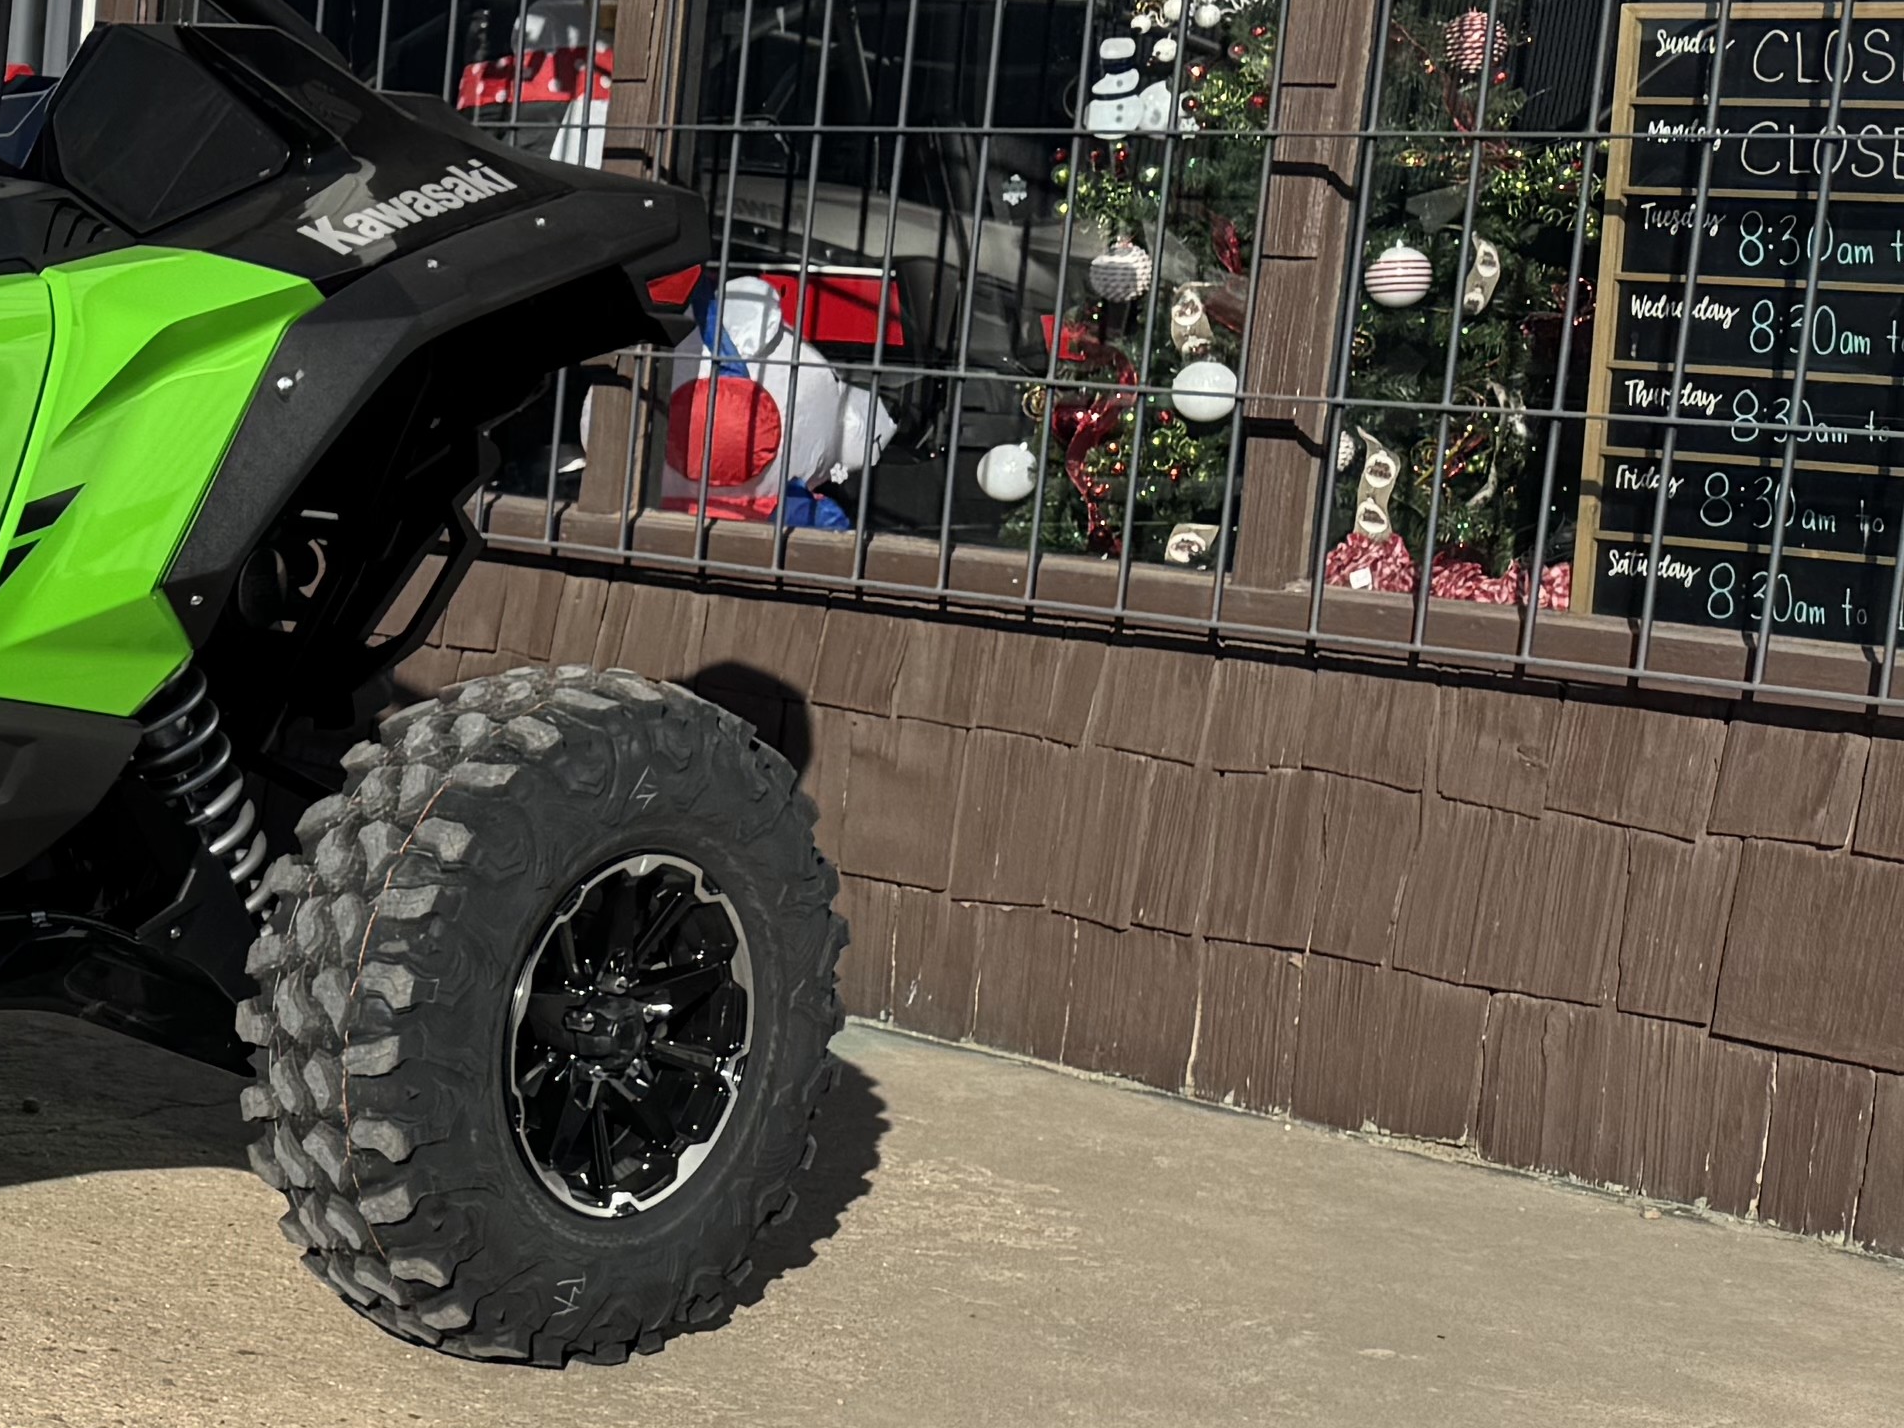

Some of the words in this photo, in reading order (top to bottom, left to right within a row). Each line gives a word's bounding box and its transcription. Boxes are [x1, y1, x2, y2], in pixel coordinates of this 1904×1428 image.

[1753, 28, 1904, 84] CLOS
[296, 158, 518, 256] Kawasaki
[1631, 294, 1740, 329] Wedneday
[1625, 379, 1723, 415] Thurday
[1856, 499, 1885, 533] to
[1608, 549, 1701, 588] Satuday
[1842, 588, 1868, 626] to
